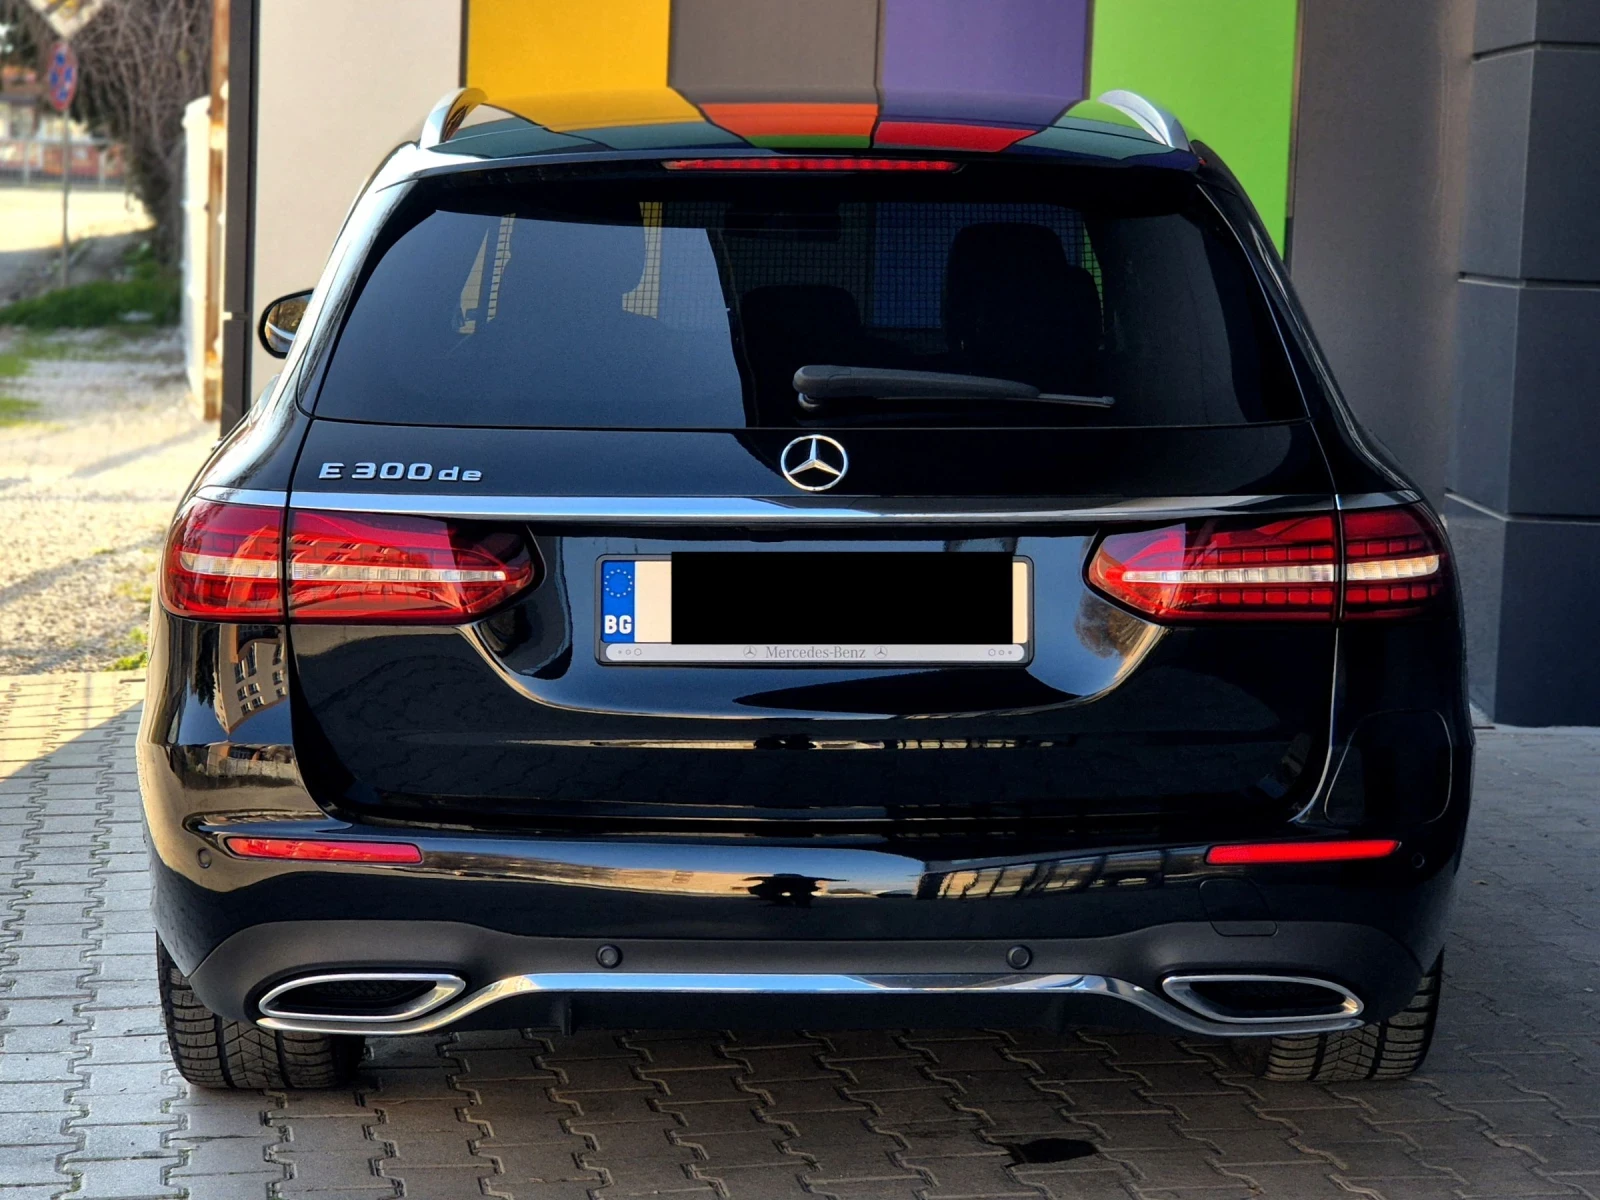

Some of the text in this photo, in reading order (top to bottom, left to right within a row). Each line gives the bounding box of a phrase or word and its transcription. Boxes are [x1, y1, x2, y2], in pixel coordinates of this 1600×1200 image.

[318, 462, 345, 479] E
[604, 615, 632, 634] BG
[765, 646, 866, 659] Mercedes-Benz
